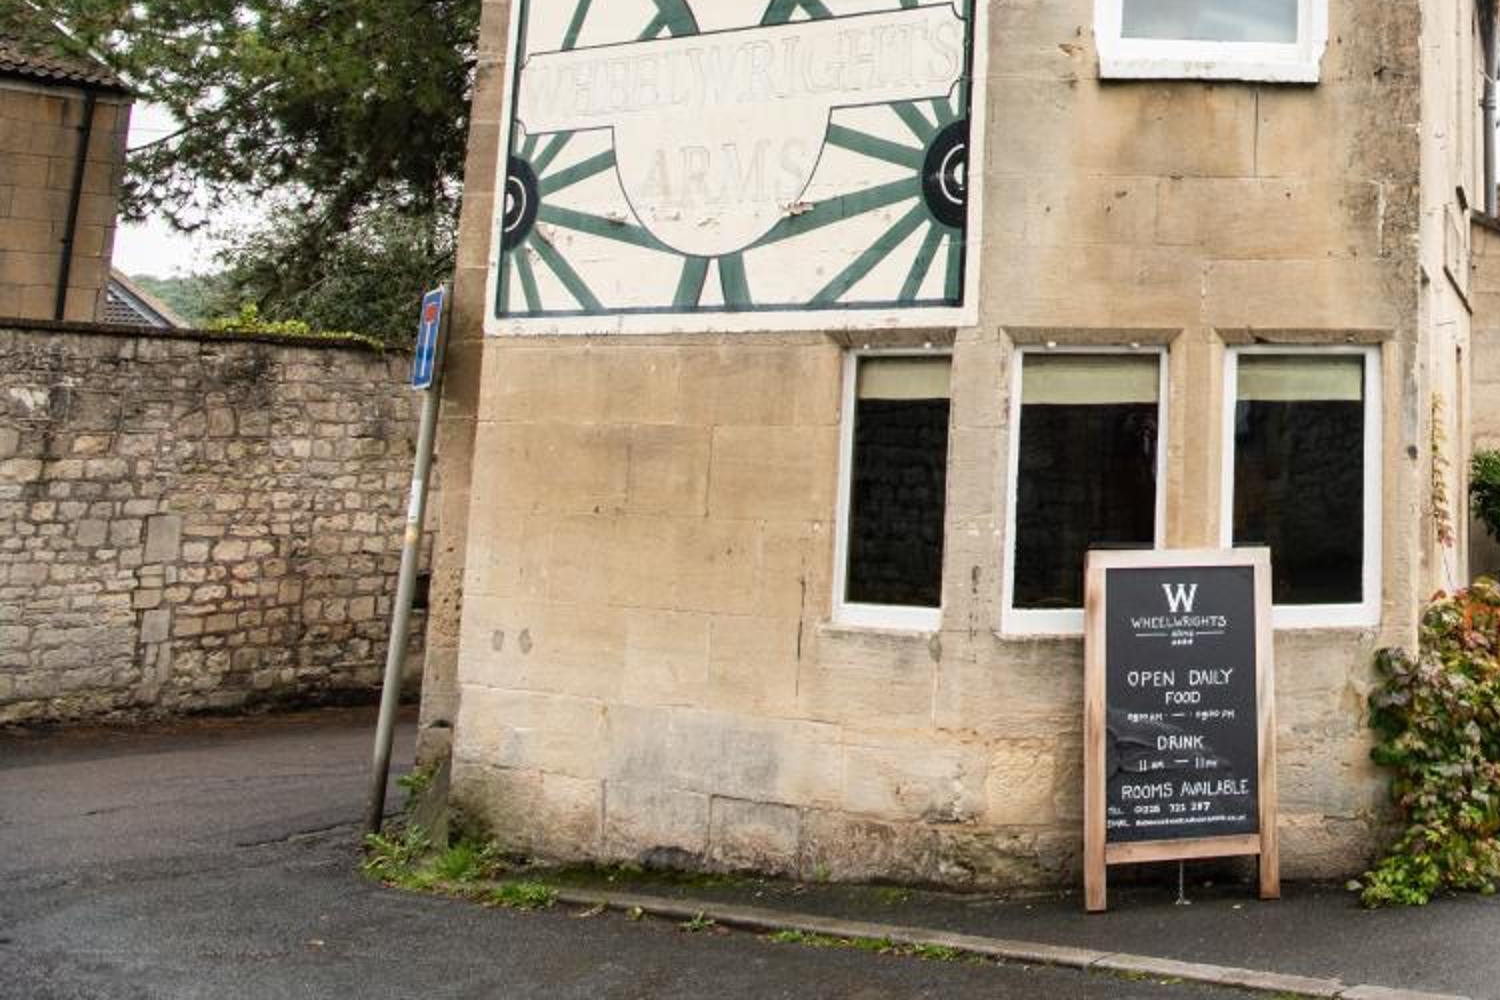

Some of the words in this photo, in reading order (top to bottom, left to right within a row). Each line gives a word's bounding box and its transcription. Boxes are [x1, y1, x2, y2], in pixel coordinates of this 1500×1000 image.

[524, 15, 960, 119] WHEELWRIGHTS
[641, 137, 812, 207] ARMS
[1161, 583, 1199, 613] W
[1130, 615, 1227, 629] WHEELWRIGHTS
[1126, 669, 1176, 688] OPEN
[1188, 667, 1234, 686] DAILY
[1165, 690, 1201, 705] FOOD
[1156, 734, 1205, 751] DRINK
[1121, 781, 1173, 800] ROOMS
[1179, 778, 1250, 797] AVAILABLE
